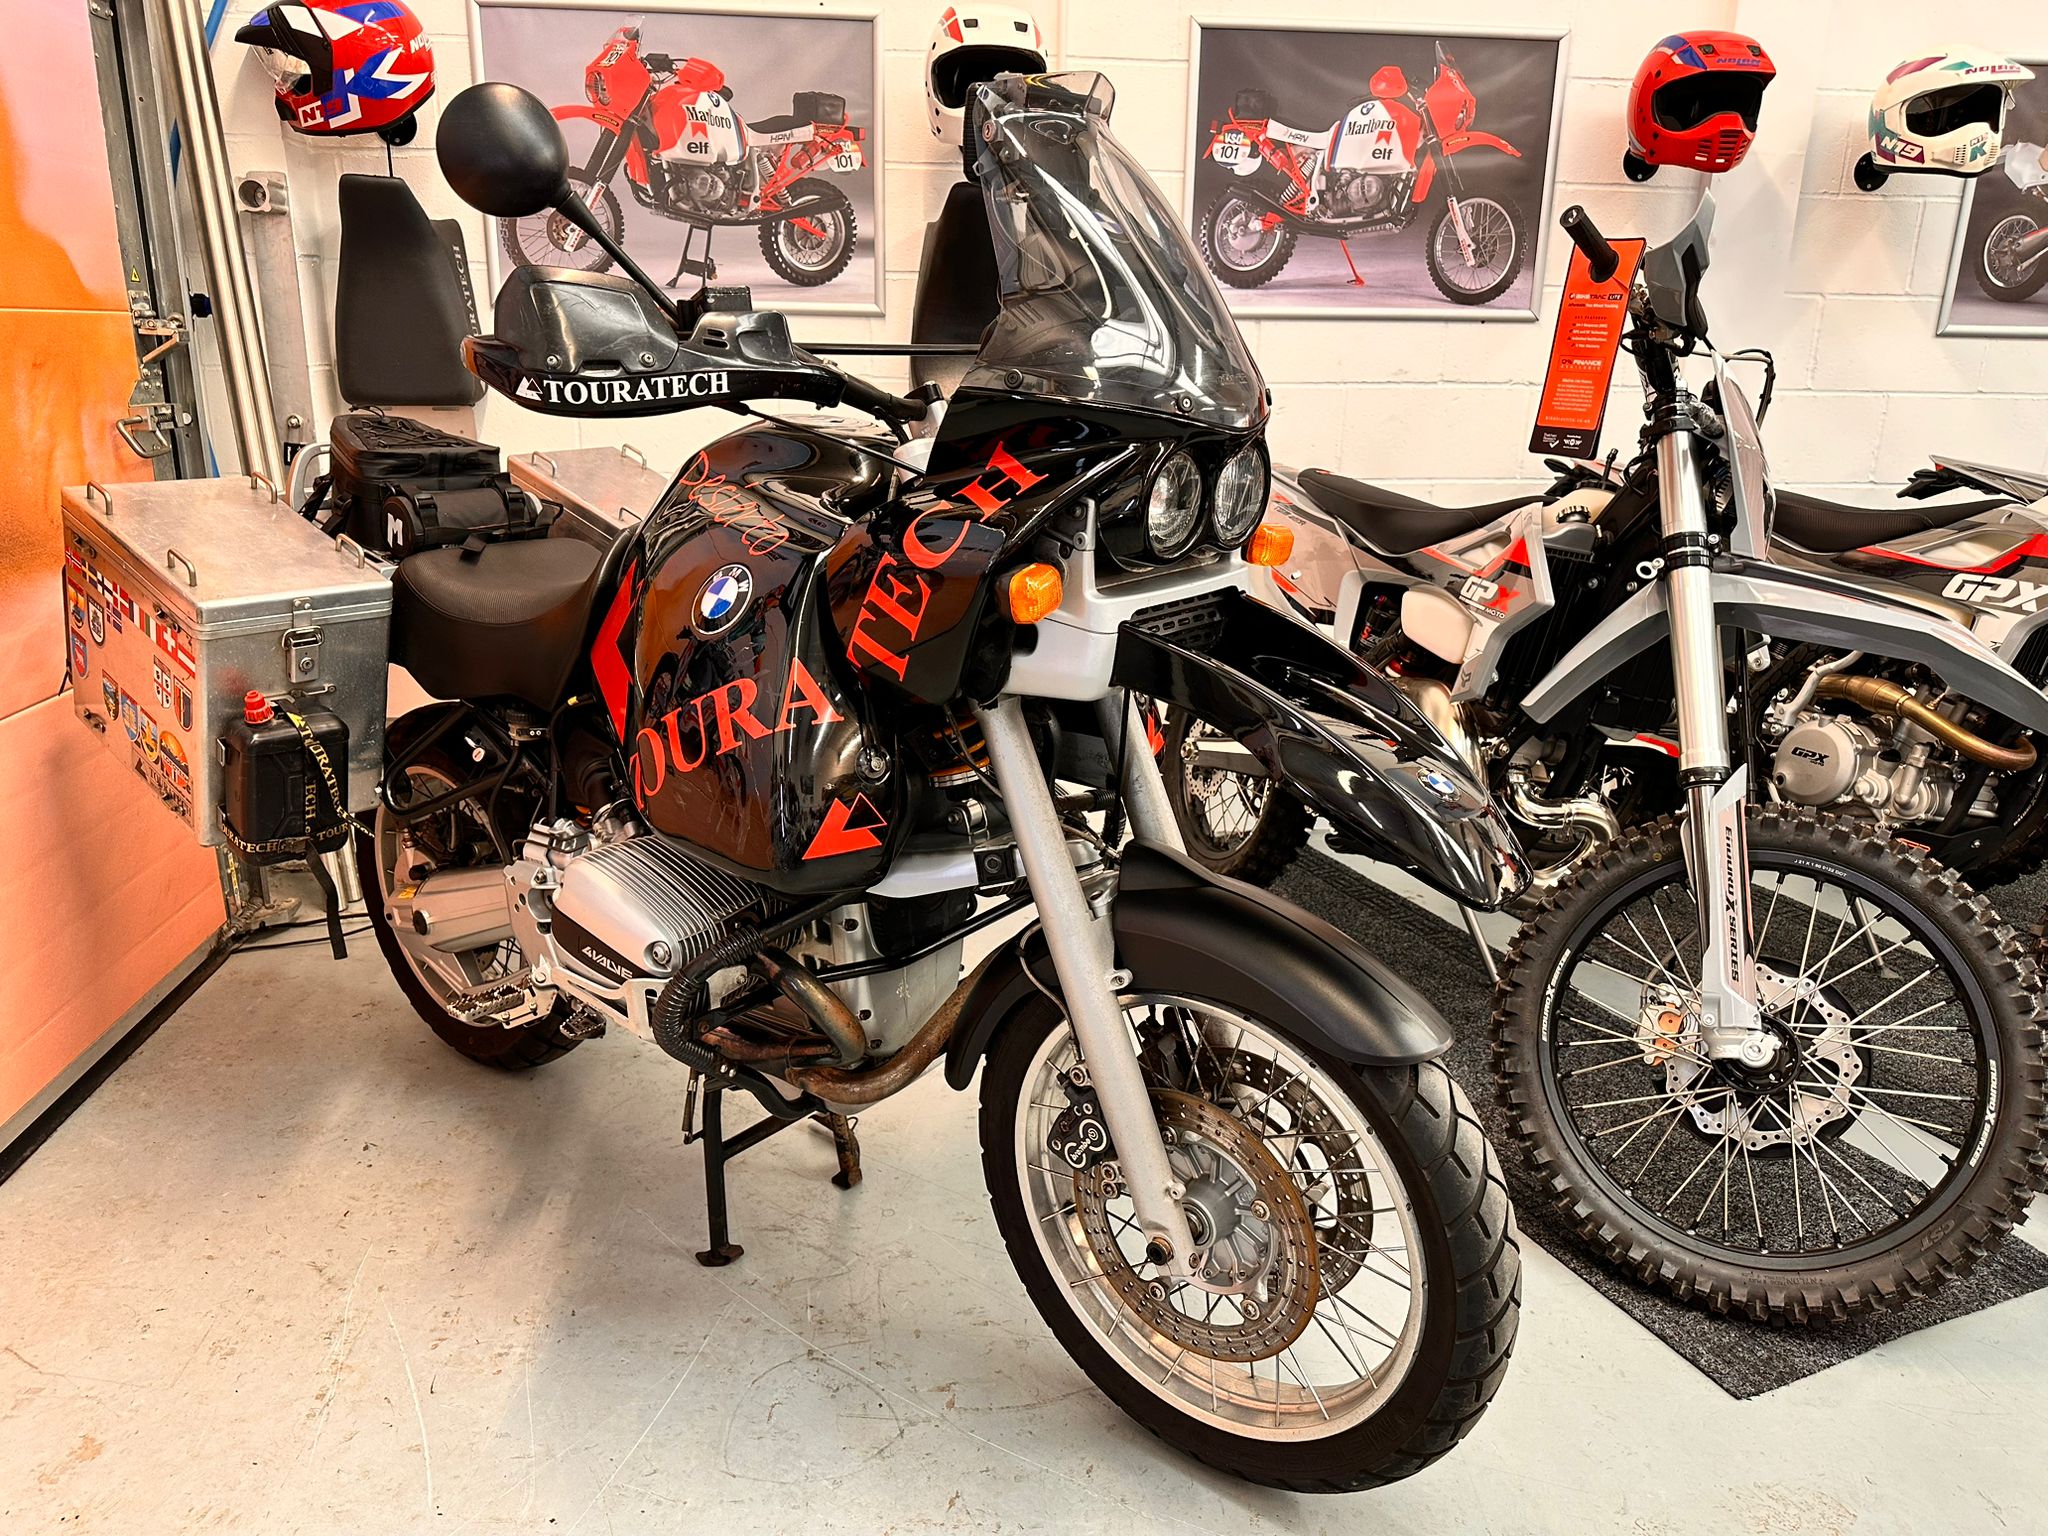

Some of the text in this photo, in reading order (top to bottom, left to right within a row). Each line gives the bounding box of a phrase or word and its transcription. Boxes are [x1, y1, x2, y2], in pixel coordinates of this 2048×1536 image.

[1964, 64, 2021, 75] NOLAN
[685, 105, 732, 130] Marlboro
[1345, 117, 1395, 137] Marlboro
[1287, 131, 1309, 143] HPN
[686, 141, 710, 154] elf
[1219, 145, 1240, 160] 101
[1371, 148, 1394, 161] elf
[833, 154, 854, 169] 101
[452, 244, 481, 337] URATECH
[543, 371, 731, 405] TOURATECH
[1460, 575, 1522, 614] GPX
[1941, 572, 2048, 613] GPX
[1485, 607, 1505, 619] MOTO
[1791, 746, 1830, 764] GPX
[1729, 915, 1740, 982] SERIES
[1070, 1138, 1091, 1161] brembo
[1919, 1219, 1956, 1252] CST
